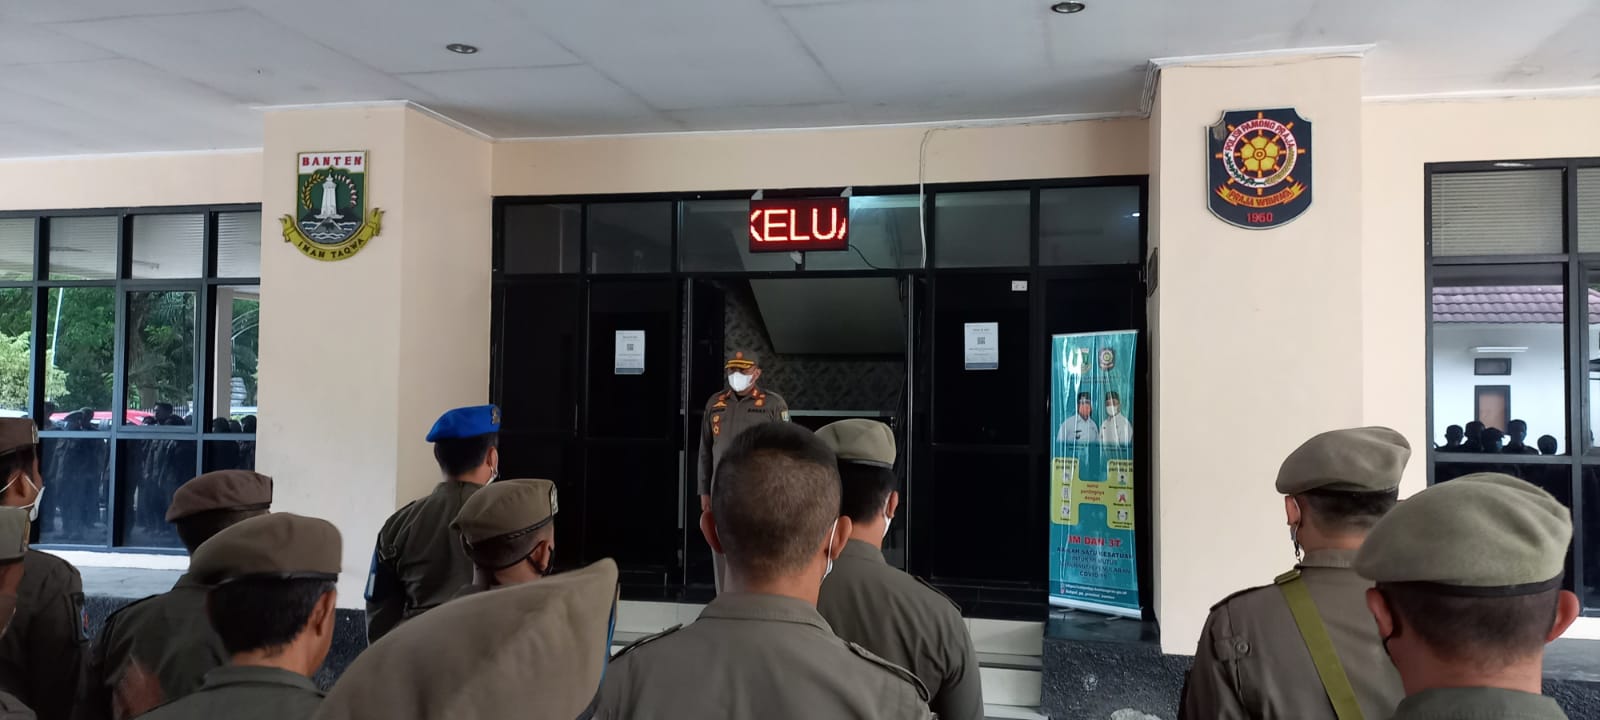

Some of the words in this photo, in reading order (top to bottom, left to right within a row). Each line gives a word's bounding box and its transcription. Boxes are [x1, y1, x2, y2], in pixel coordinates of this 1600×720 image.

[1225, 130, 1242, 151] POLISI
[1241, 120, 1275, 133] PAMONG
[1274, 124, 1296, 148] PRAJA
[302, 156, 362, 167] BANTEN
[1228, 190, 1254, 206] PRAJA
[1247, 212, 1273, 223] 1960
[298, 241, 326, 258] IMAN
[331, 239, 365, 258] TAQWA
